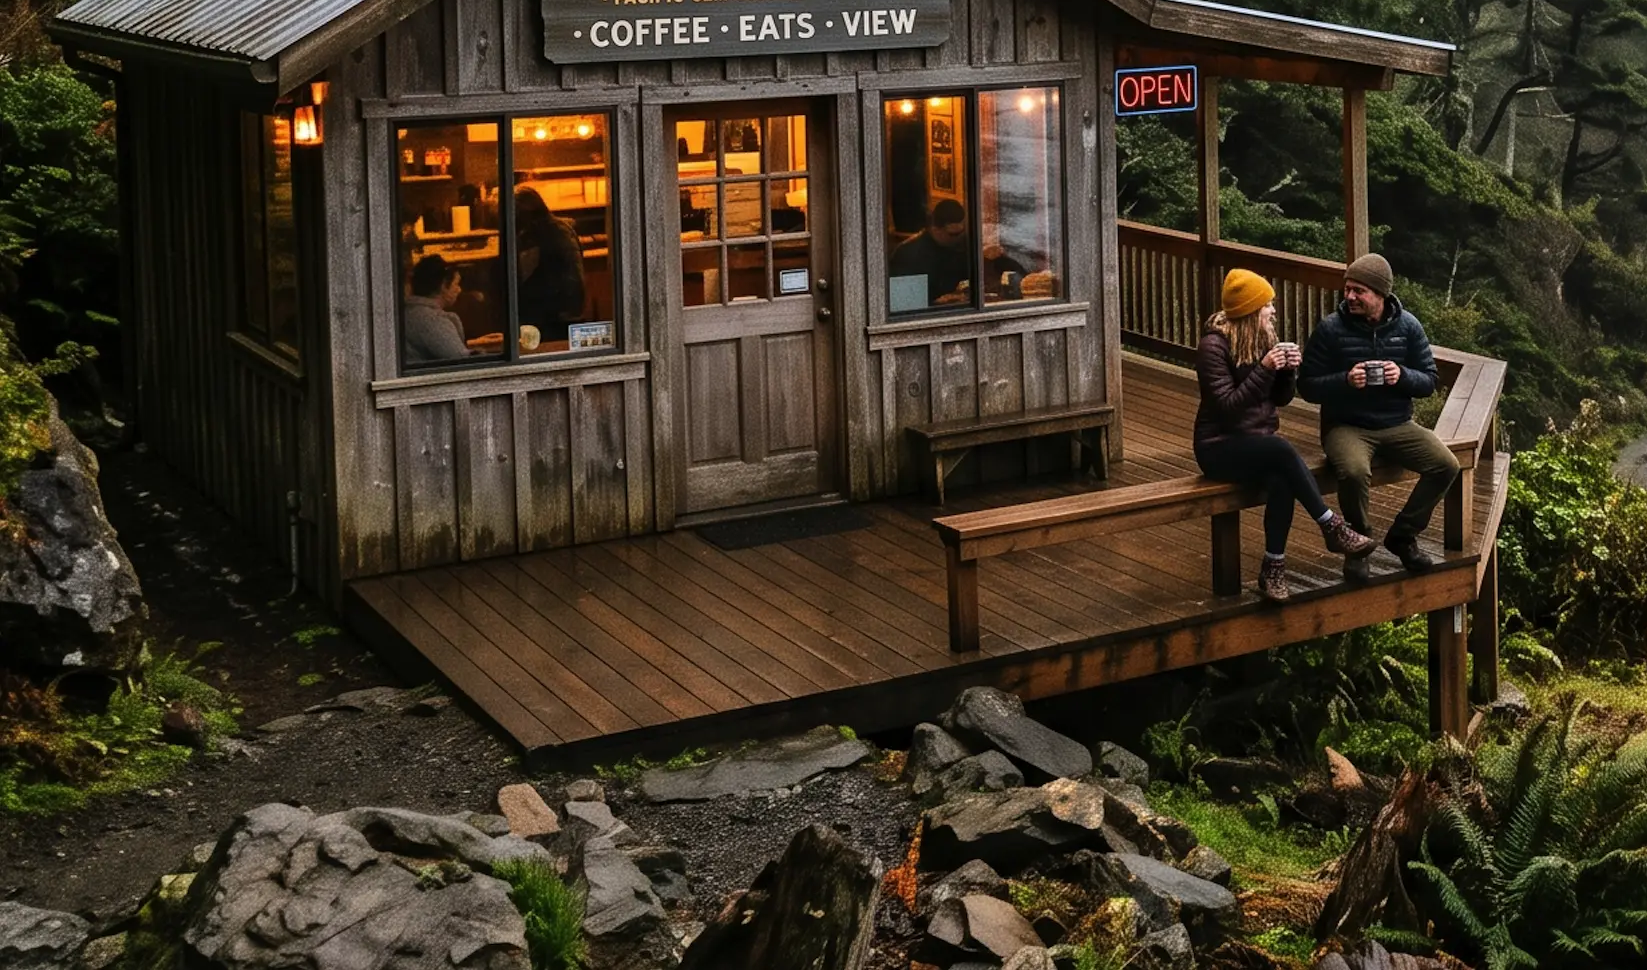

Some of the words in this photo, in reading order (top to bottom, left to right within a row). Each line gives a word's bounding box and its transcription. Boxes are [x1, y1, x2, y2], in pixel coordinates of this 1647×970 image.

[590, 16, 710, 47] COFFEE
[739, 13, 815, 42] EATS
[841, 9, 917, 37] VIEW
[1120, 73, 1191, 107] OPEN
